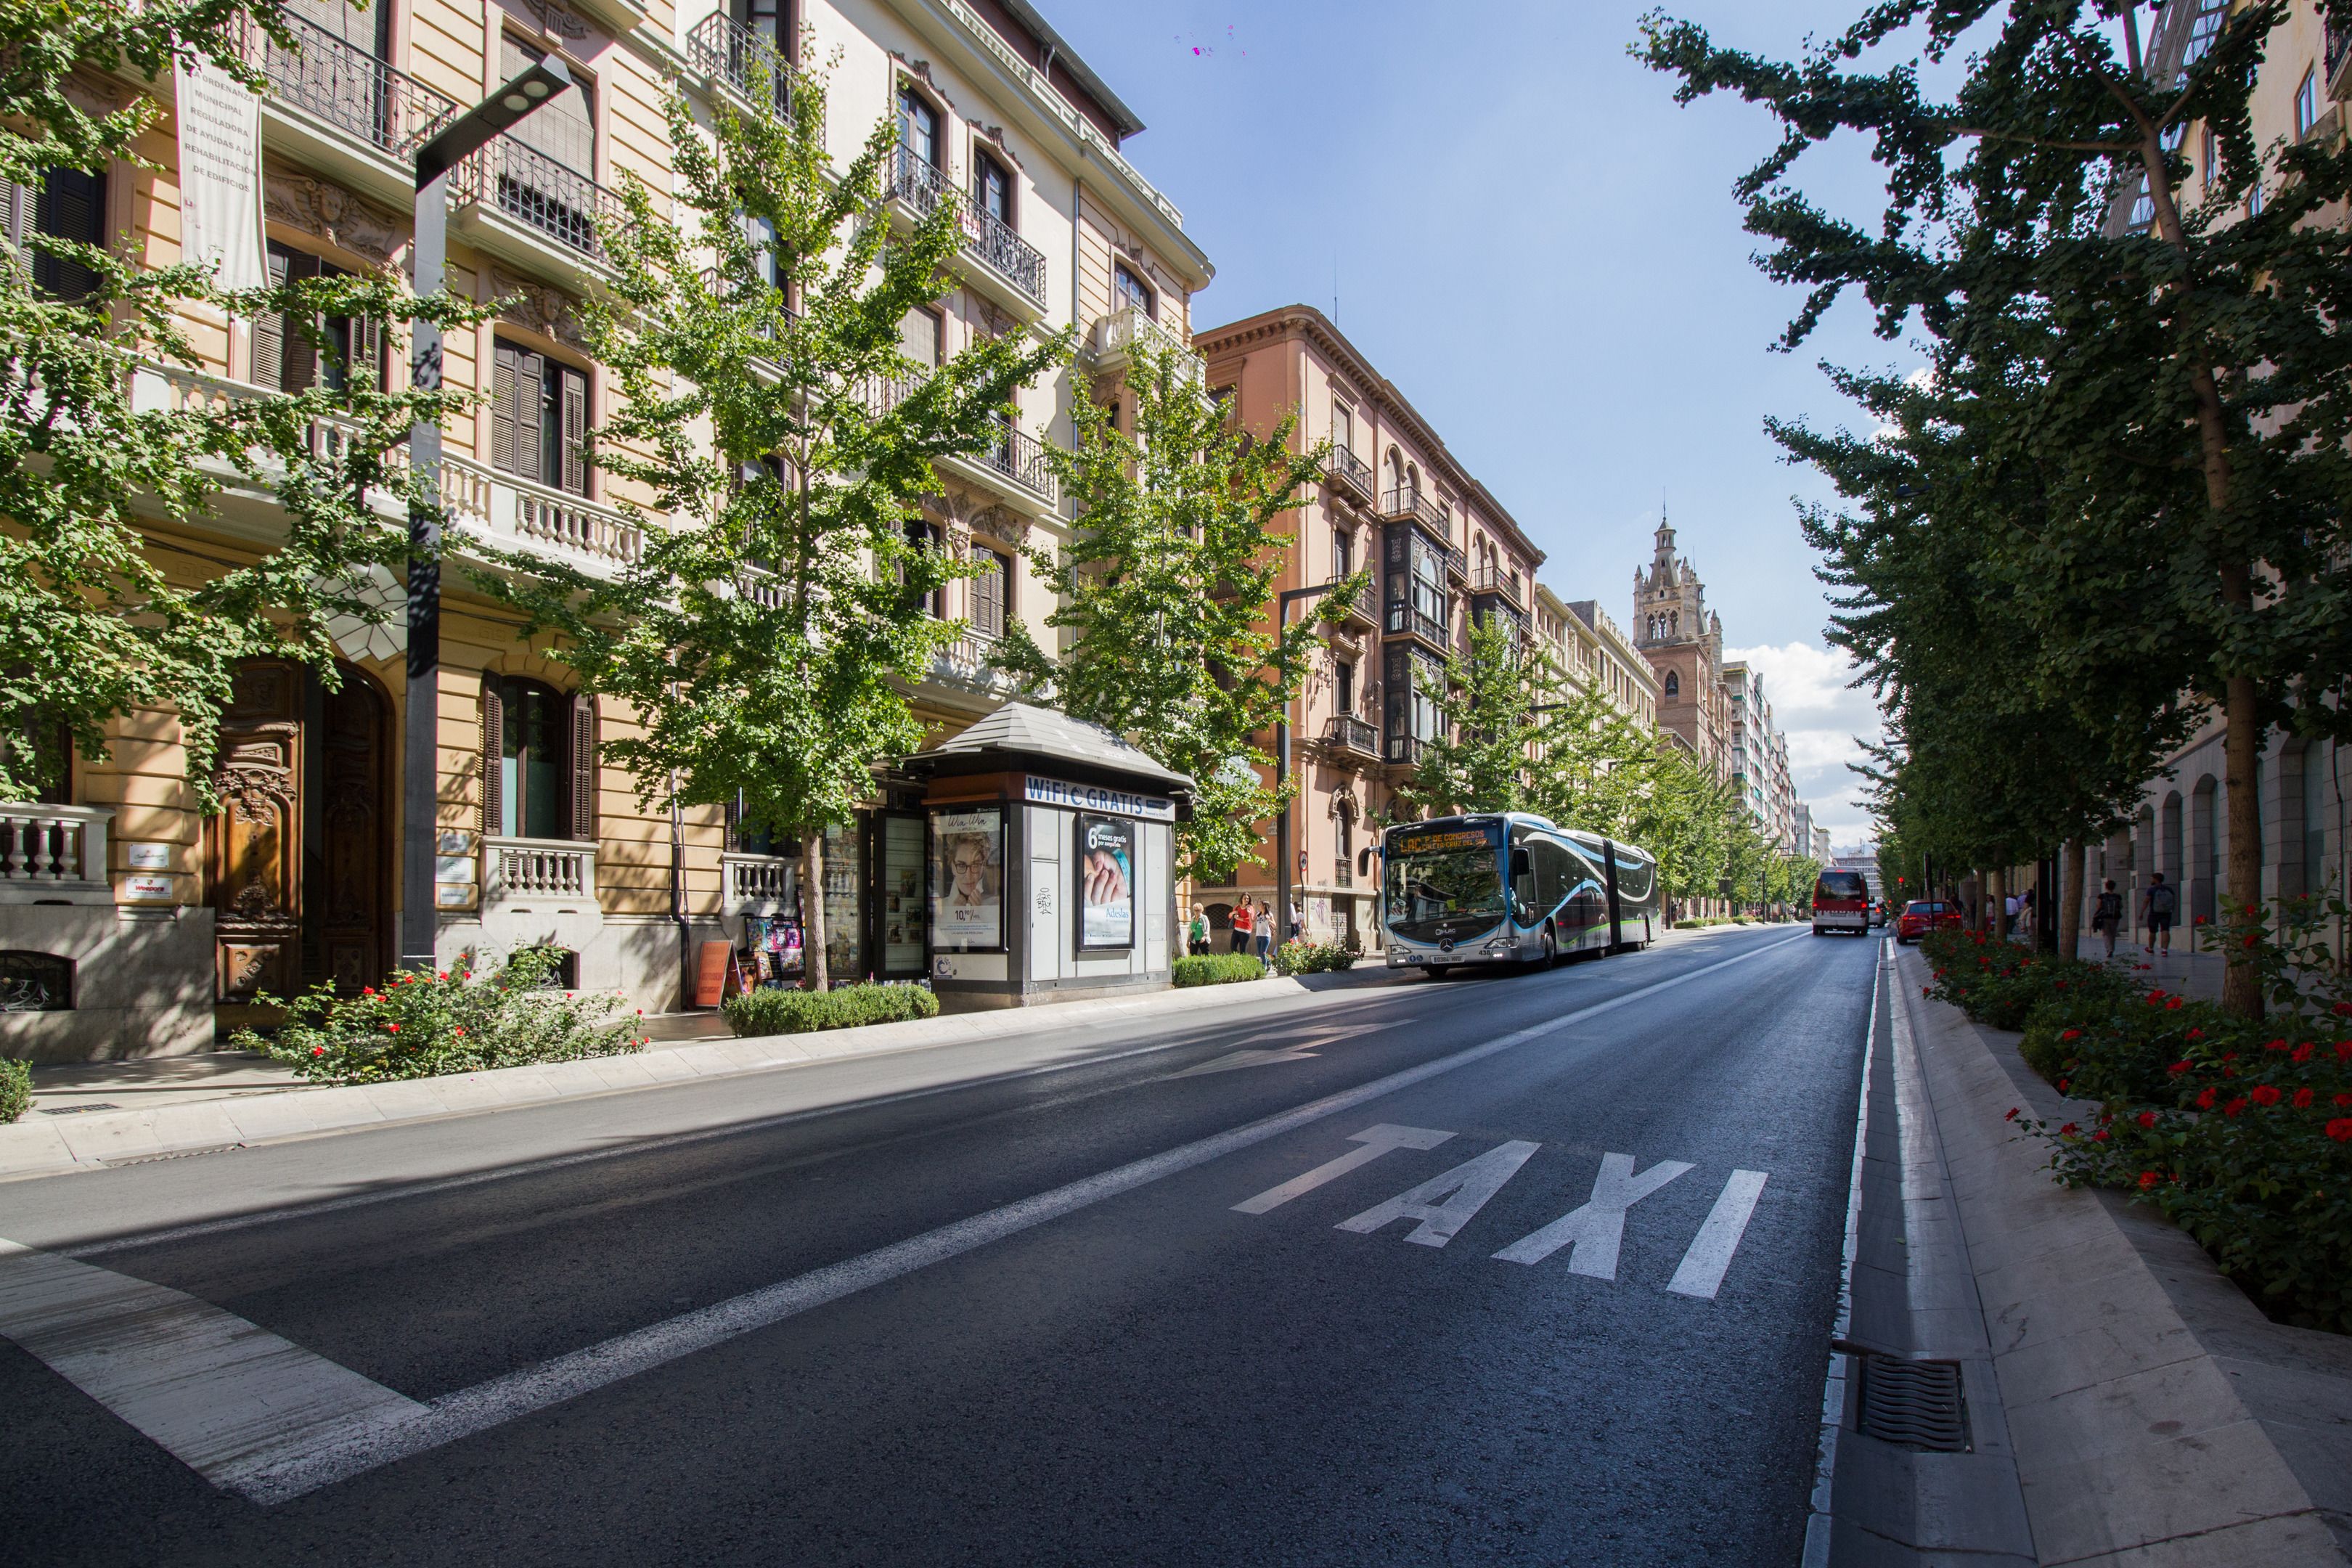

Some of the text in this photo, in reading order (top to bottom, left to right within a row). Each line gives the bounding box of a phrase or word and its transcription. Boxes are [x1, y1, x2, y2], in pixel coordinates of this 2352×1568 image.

[203, 75, 254, 103] ORDENANZA
[195, 89, 243, 117] MUNICIPAL
[190, 107, 249, 138] REGULADORA
[186, 123, 198, 134] DE
[200, 130, 234, 150] AYUDAS
[243, 147, 254, 158] LA
[193, 165, 250, 192] DE EDIFICIOS
[1086, 788, 1143, 815] GRATIS
[1088, 827, 1098, 849] 6
[1113, 835, 1127, 844] gratis
[1444, 830, 1485, 842] CONGRESOS
[1106, 907, 1129, 918] Adeslas
[1228, 1122, 1769, 1299] TAXI
